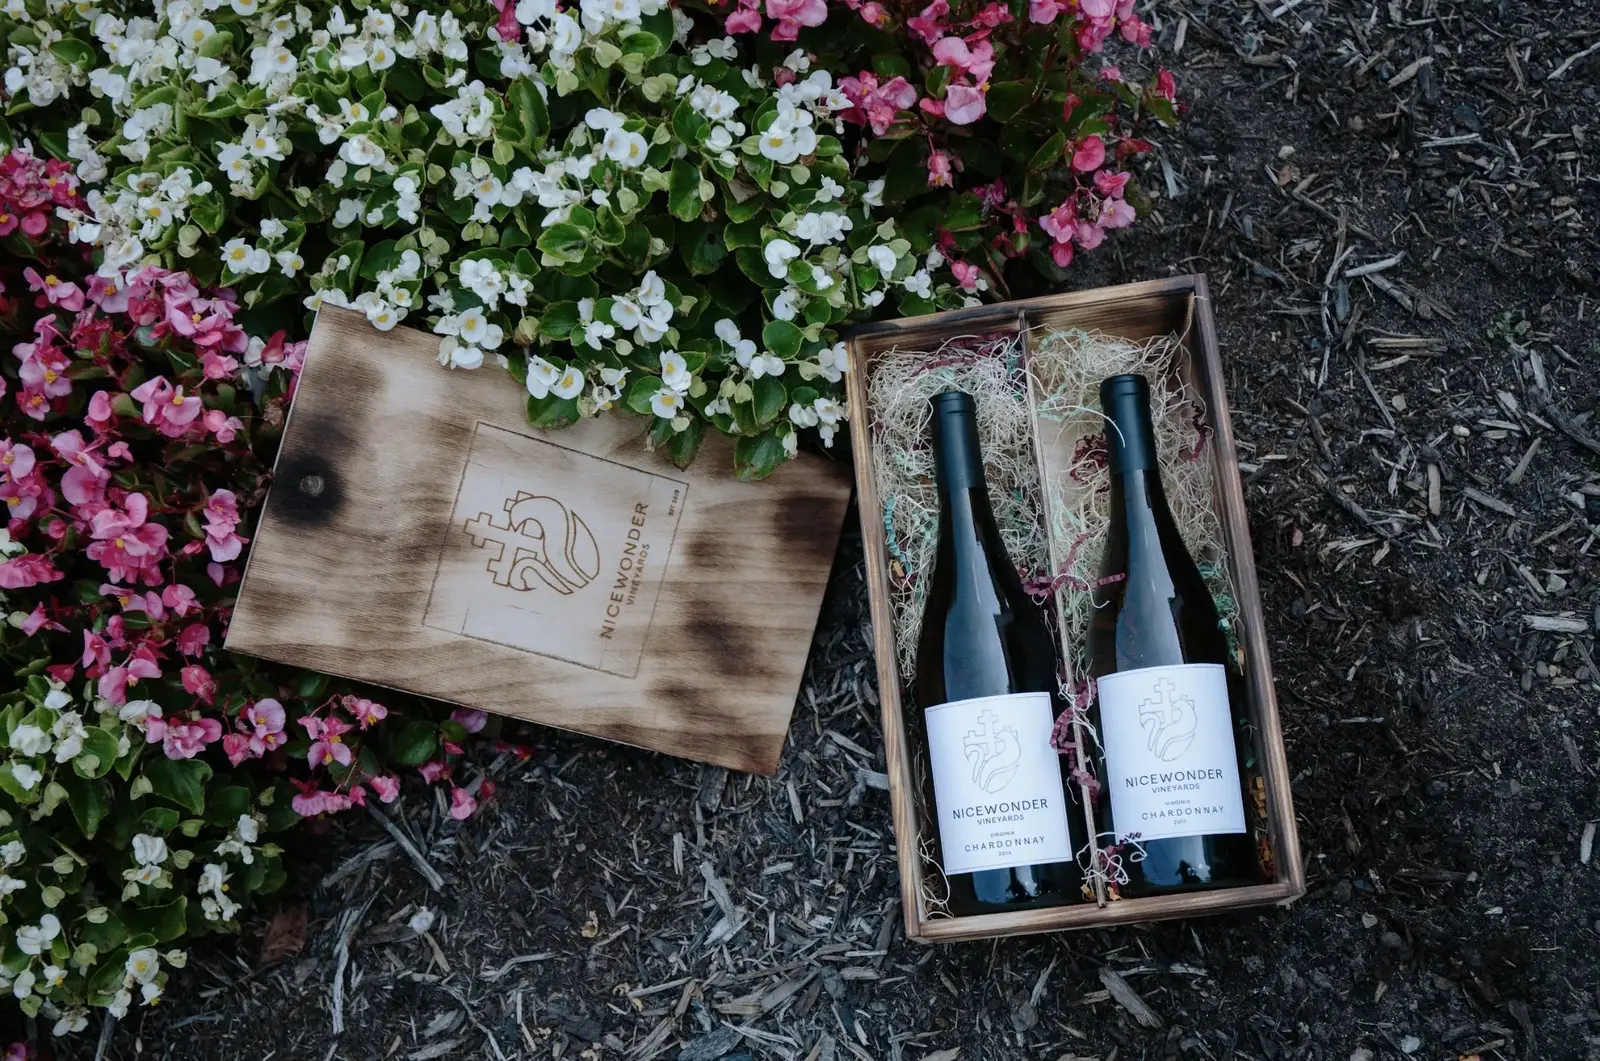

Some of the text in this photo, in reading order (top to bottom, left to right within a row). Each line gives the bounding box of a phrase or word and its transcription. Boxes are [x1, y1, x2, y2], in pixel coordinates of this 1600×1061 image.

[600, 502, 649, 640] NICEWONDER
[626, 543, 650, 606] VINEYARDS
[1125, 768, 1224, 788] NICEWONDER
[1151, 782, 1201, 794] VINEYARDS
[952, 798, 1048, 820] NICEWONDER
[1141, 805, 1224, 821] CHARDONNAY
[977, 813, 1025, 826] VINEYARDS
[964, 835, 1045, 853] CHARDONNAY
